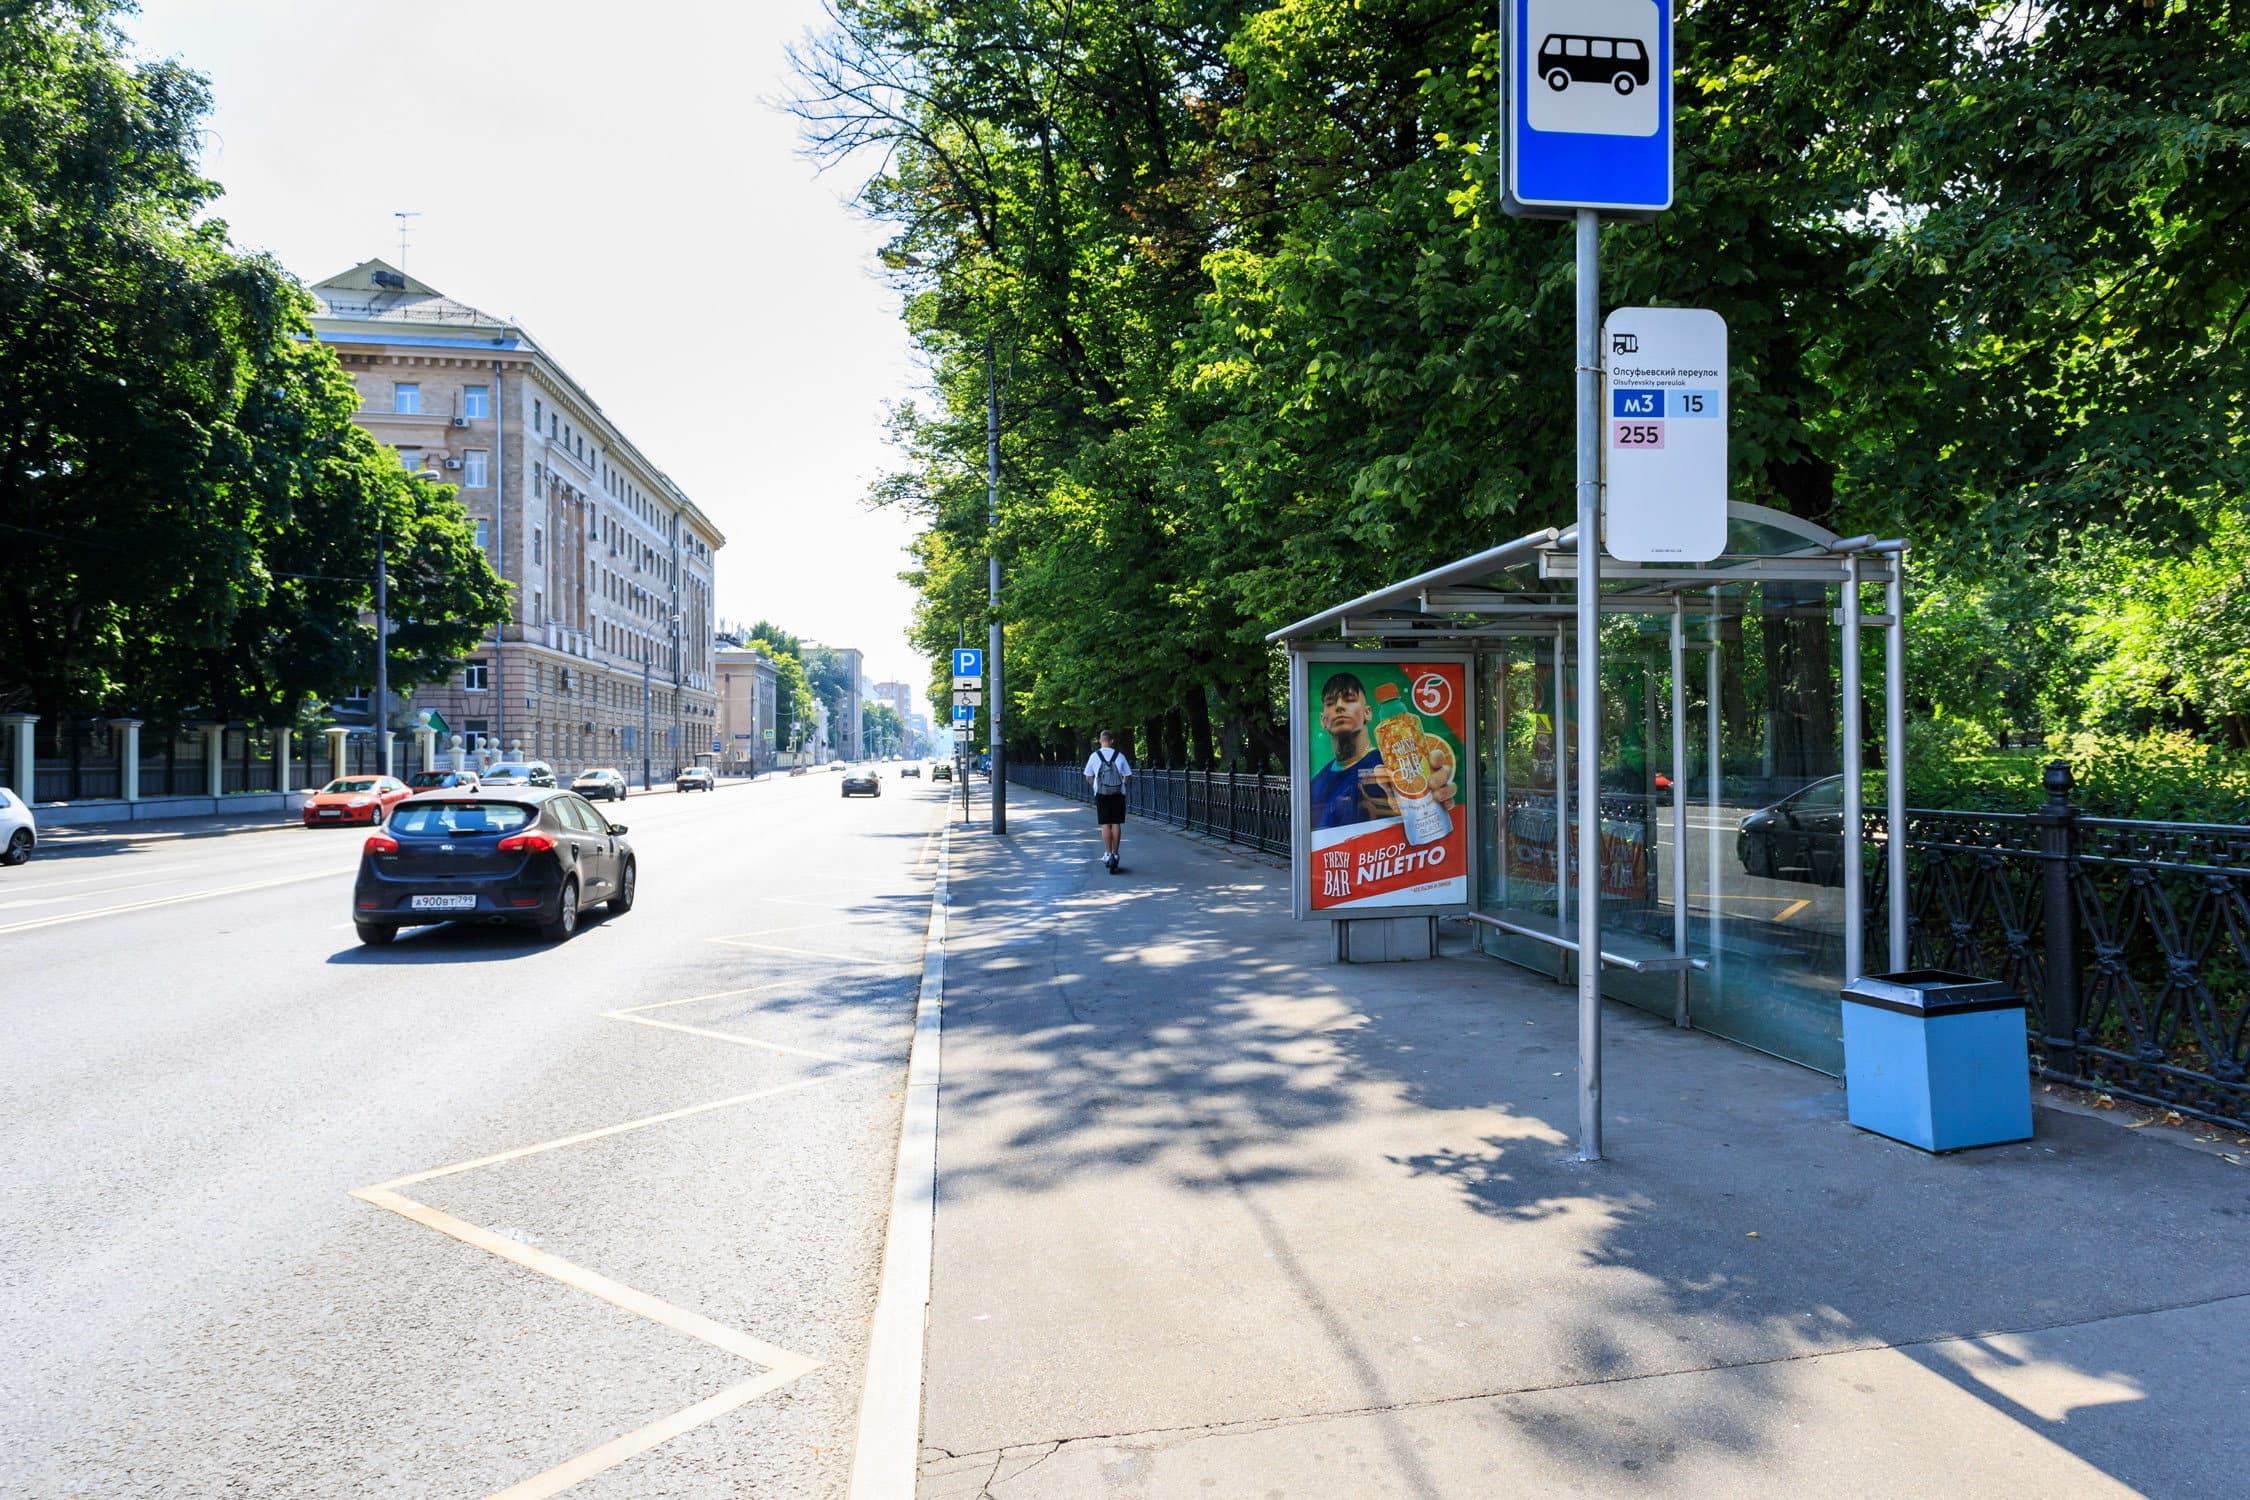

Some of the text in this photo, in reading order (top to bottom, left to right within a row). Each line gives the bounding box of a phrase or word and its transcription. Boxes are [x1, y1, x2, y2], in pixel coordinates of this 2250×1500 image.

[1613, 367, 1719, 378] Олсуфьевский переулок
[1683, 395, 1704, 413] 15
[1620, 426, 1659, 444] 255
[1323, 851, 1350, 869] FRESH
[1358, 842, 1406, 866] ВЫБОР
[1356, 845, 1446, 886] NILETTO
[1322, 869, 1352, 897] BAR
